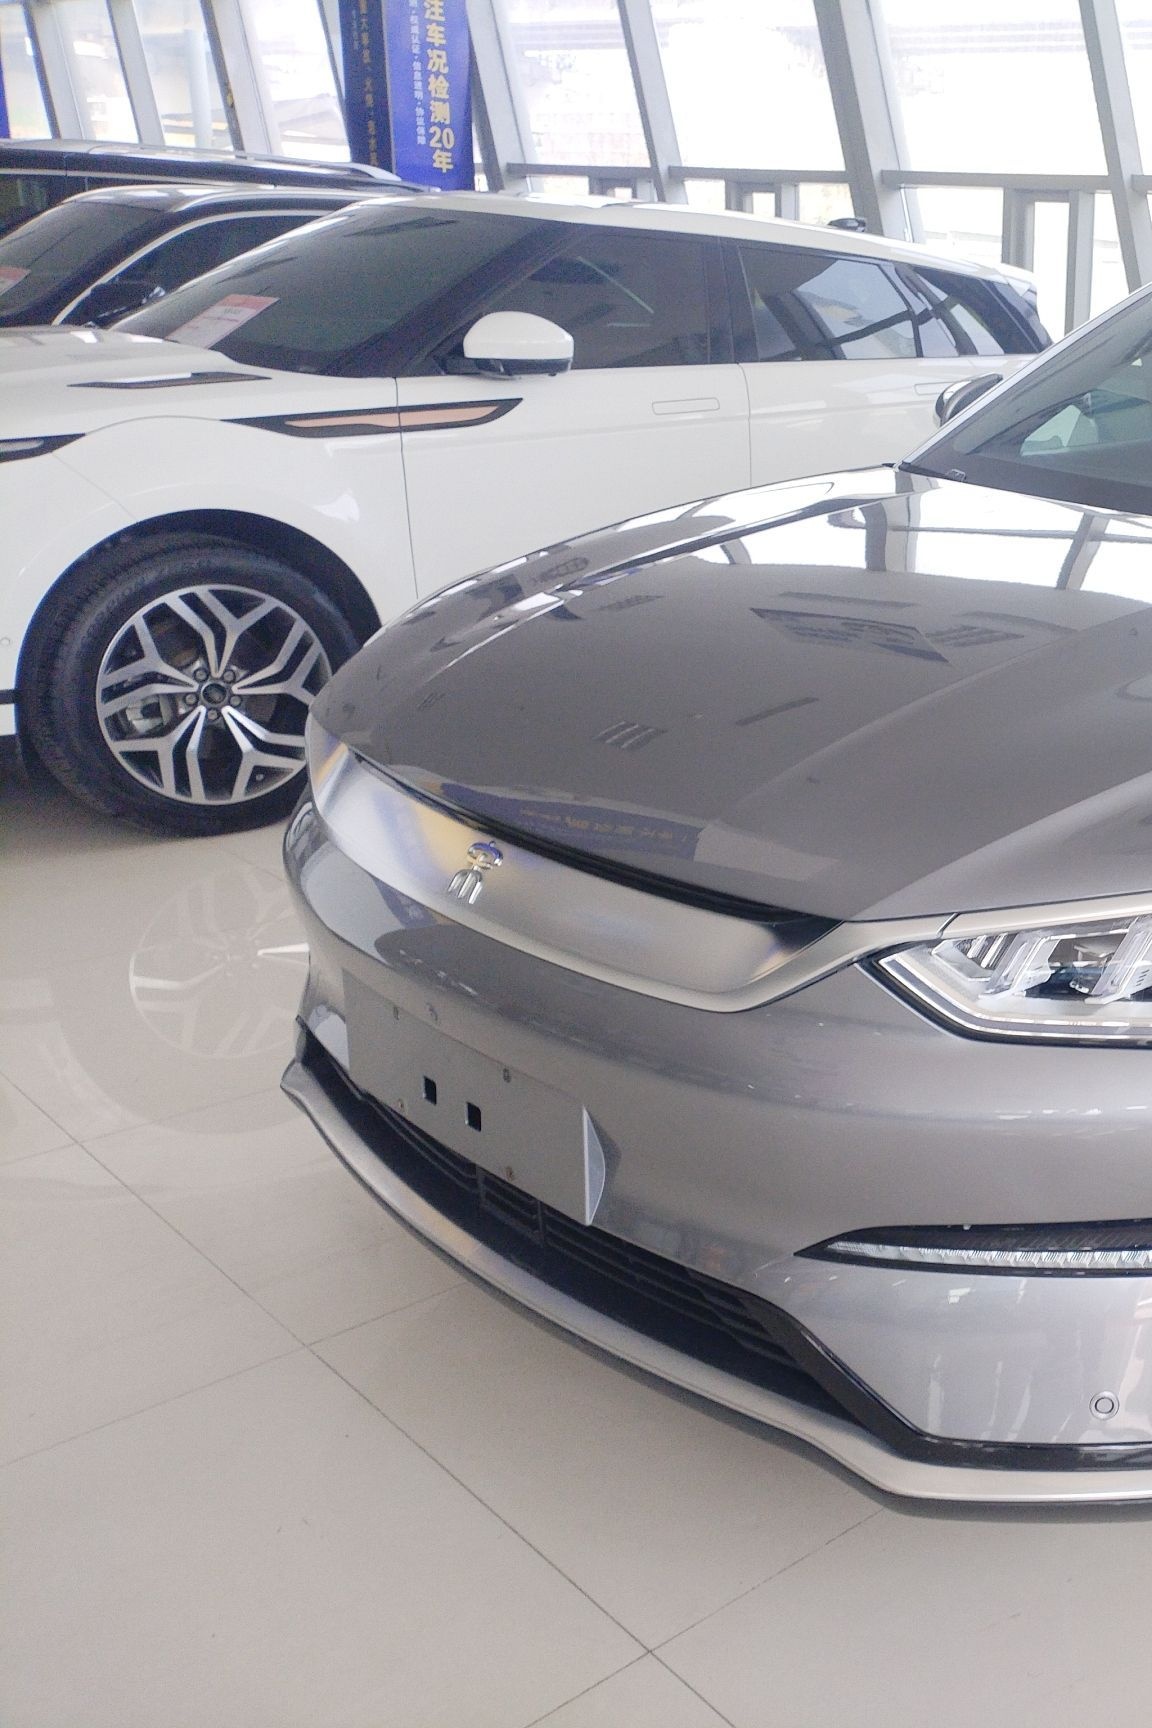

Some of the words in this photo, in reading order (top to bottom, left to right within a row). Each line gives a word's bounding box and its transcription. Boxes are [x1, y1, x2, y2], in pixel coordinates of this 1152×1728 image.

[423, 0, 455, 173] 注车况检测20年
